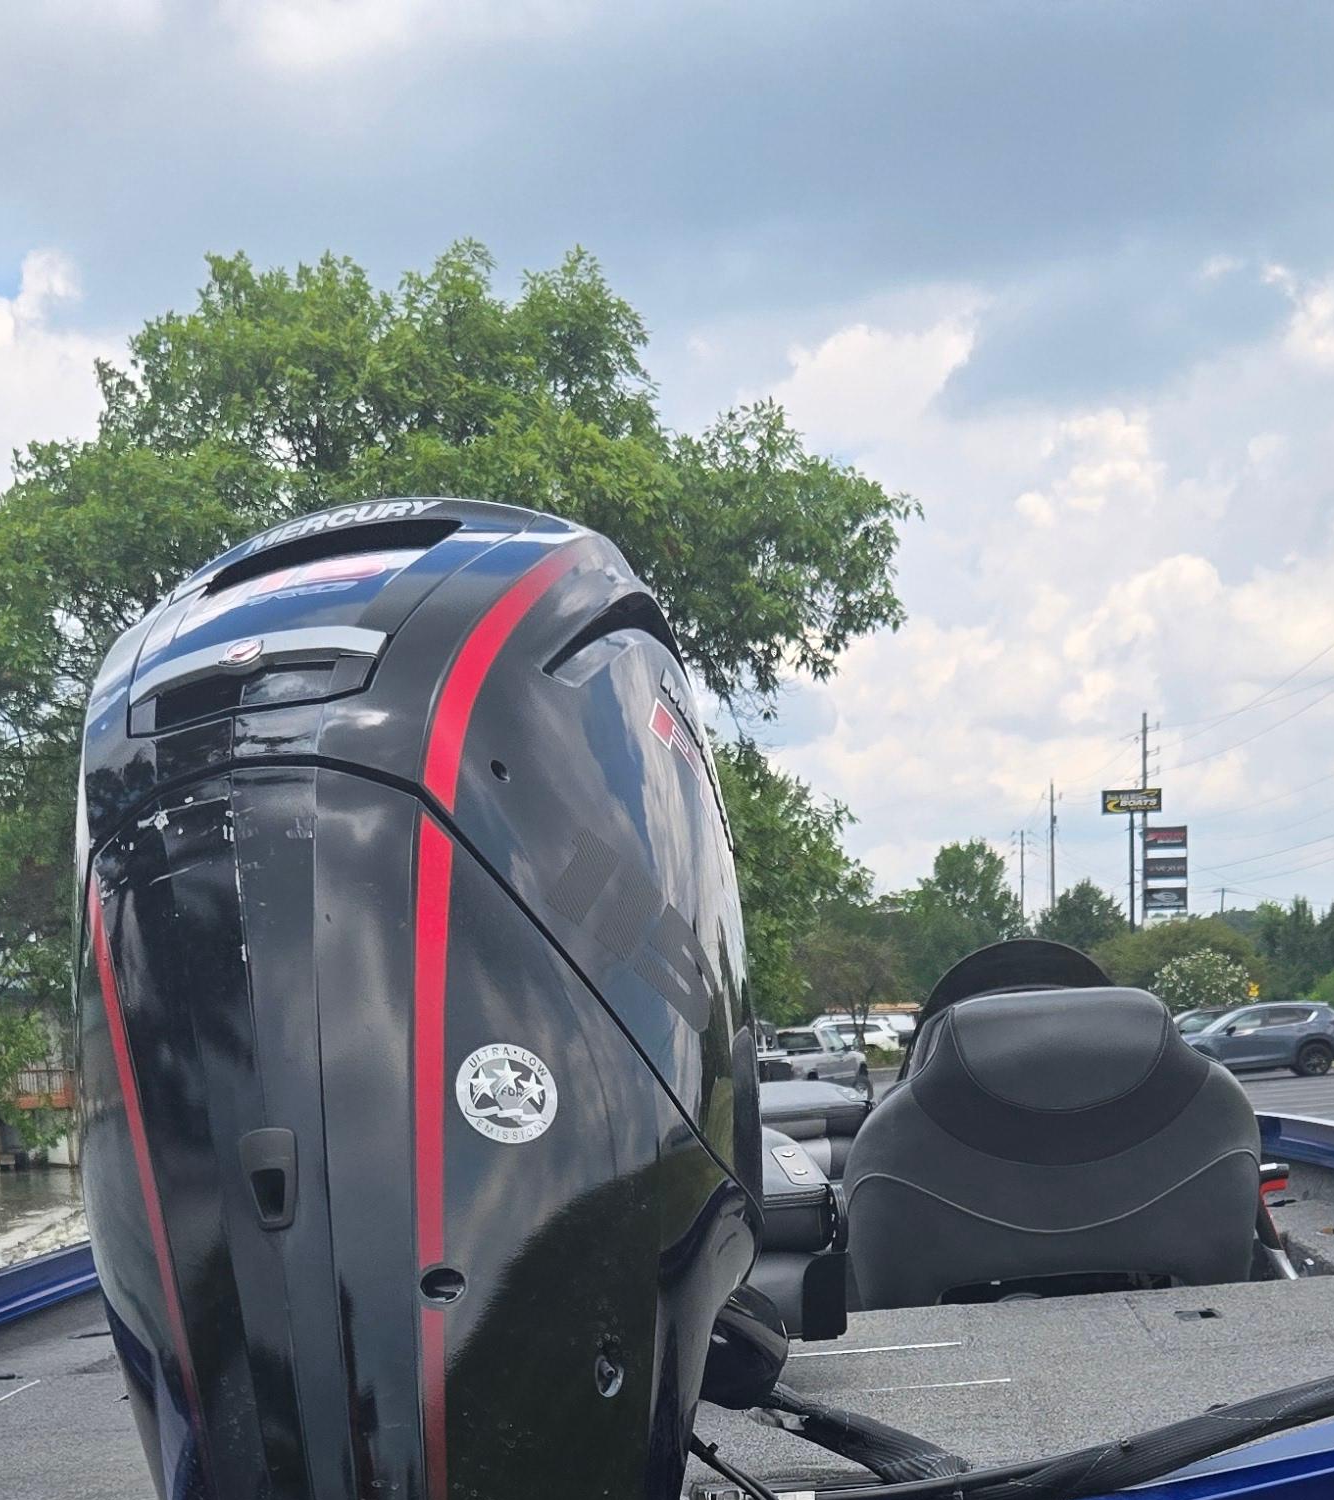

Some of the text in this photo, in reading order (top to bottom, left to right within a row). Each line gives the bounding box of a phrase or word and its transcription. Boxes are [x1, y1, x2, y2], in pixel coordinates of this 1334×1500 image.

[243, 501, 442, 556] MERCURY
[468, 1047, 548, 1077] ULTRA LOW
[476, 1119, 543, 1141] EMISSION
